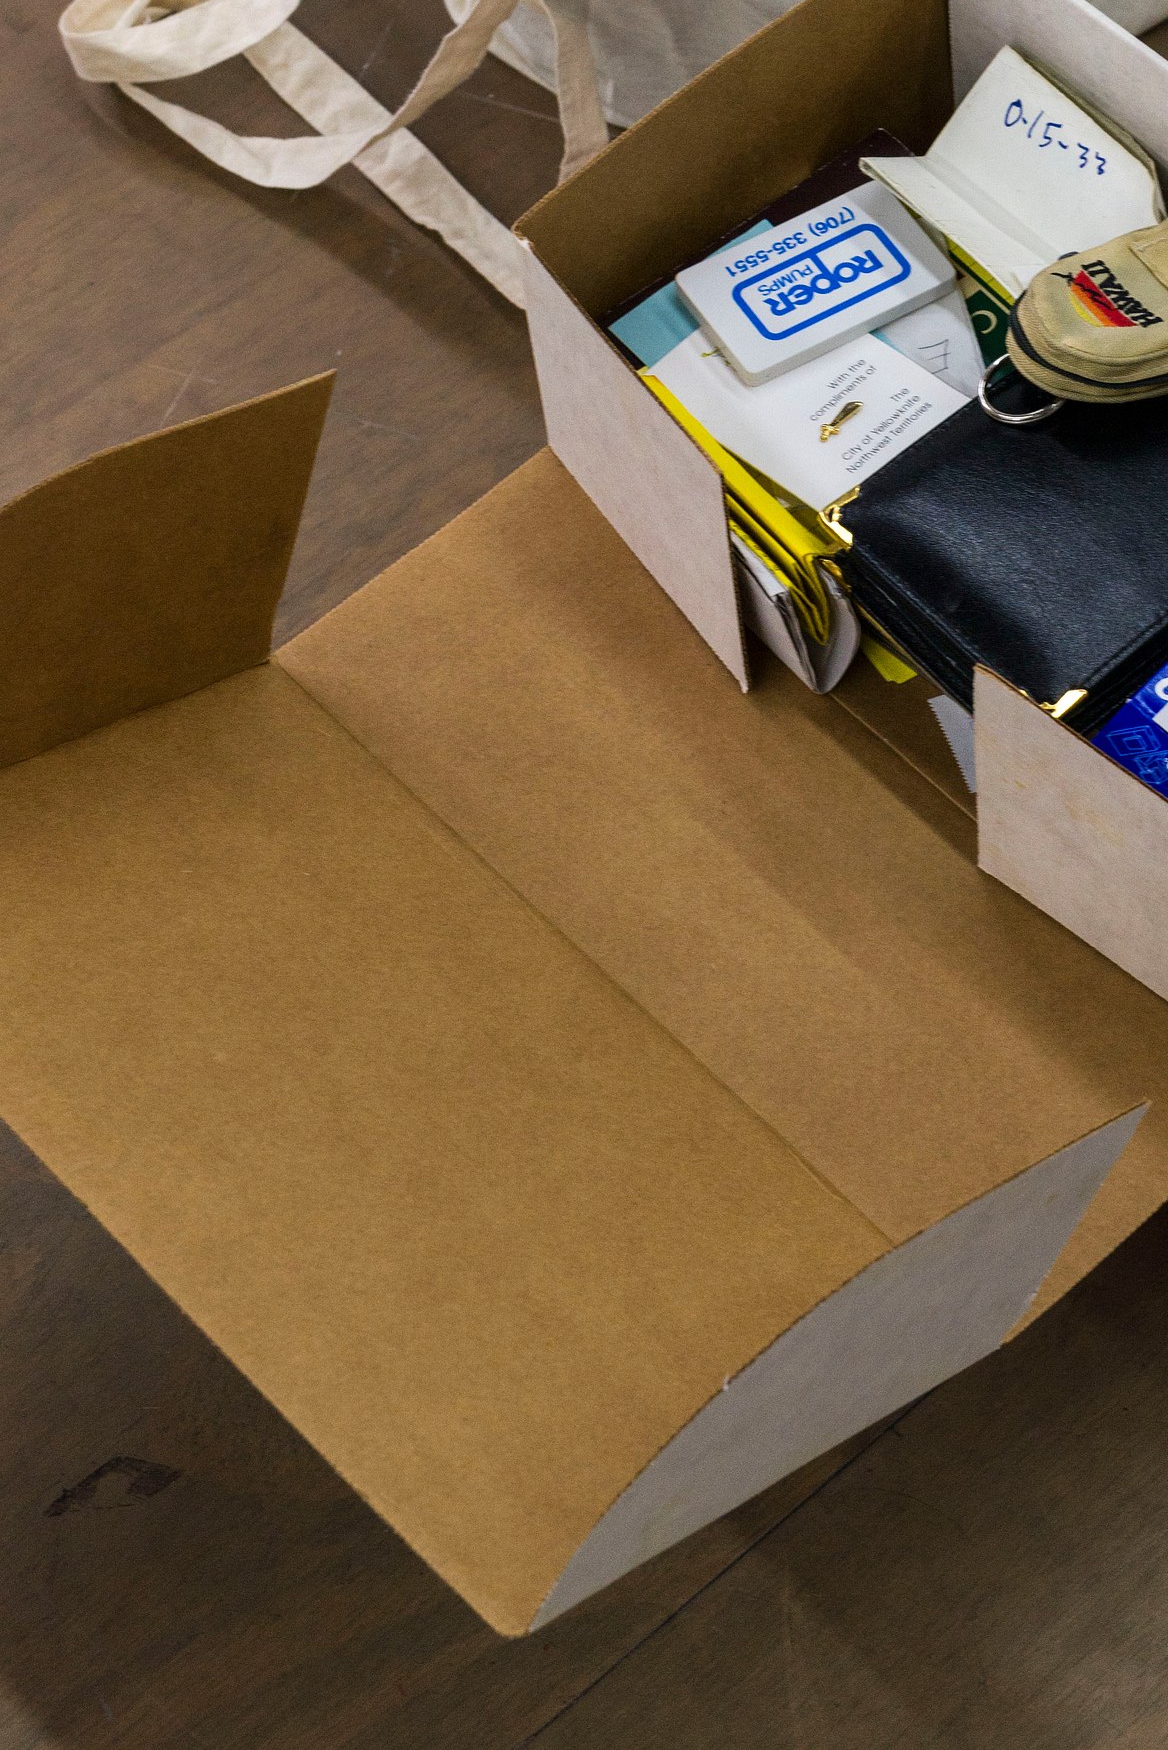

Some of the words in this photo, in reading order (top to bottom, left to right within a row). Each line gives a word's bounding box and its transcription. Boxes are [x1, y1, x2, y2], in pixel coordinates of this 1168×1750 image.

[808, 206, 855, 237] (706)
[725, 232, 807, 277] 335-5551
[757, 264, 814, 296] PUMPS
[1081, 259, 1164, 329] HAWAII
[809, 375, 867, 421] compliments
[866, 365, 878, 375] of
[827, 372, 851, 389] With
[848, 359, 866, 372] the
[889, 388, 910, 402] The
[841, 444, 863, 461] City
[861, 435, 874, 445] of
[870, 395, 921, 436] Yellowknife
[845, 435, 893, 474] Northwest
[890, 402, 933, 437] Territories
